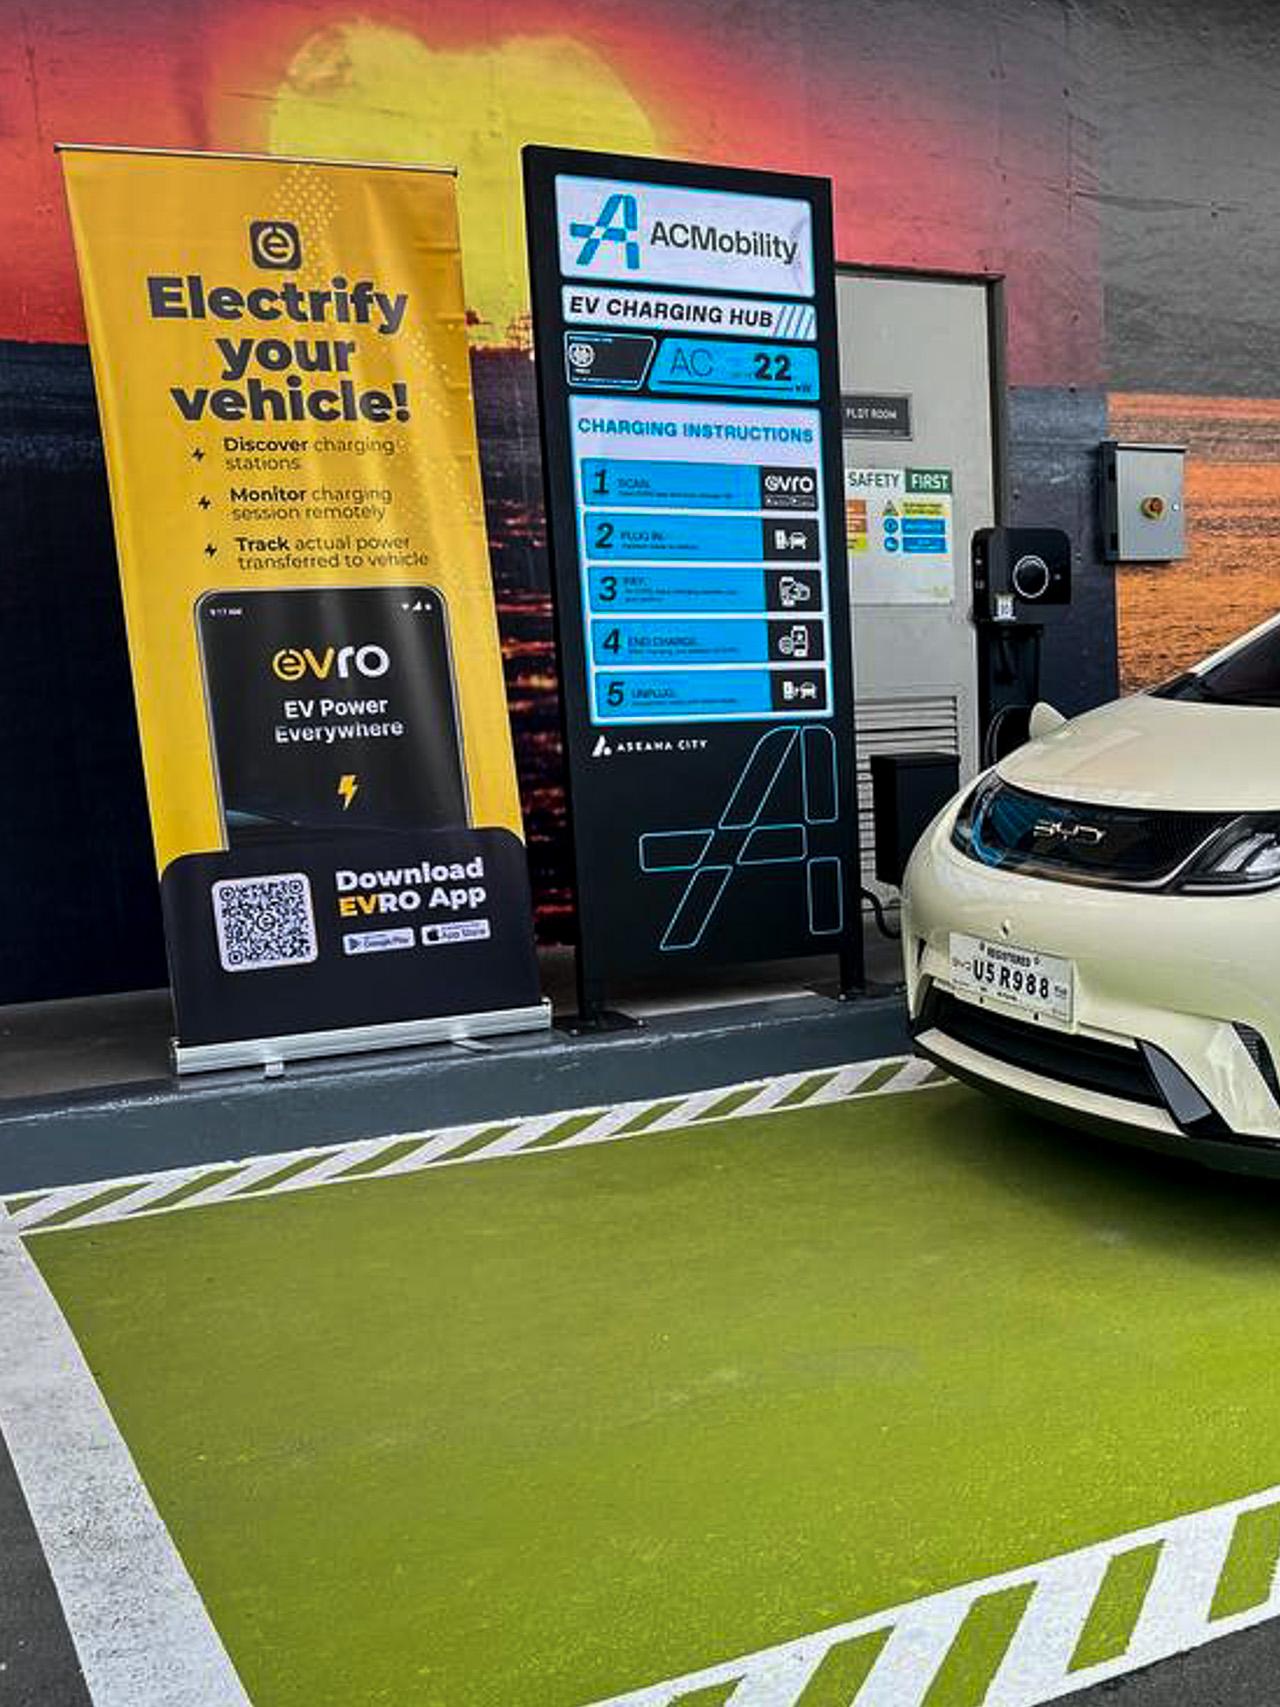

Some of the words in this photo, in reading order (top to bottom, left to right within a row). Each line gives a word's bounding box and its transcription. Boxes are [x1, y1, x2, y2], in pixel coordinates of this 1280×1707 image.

[650, 221, 797, 265] ACMobility
[147, 275, 408, 335] Electrify
[570, 296, 600, 315] EV
[606, 298, 722, 324] CHARGING
[730, 306, 773, 328] HUB
[216, 338, 355, 381] your
[670, 347, 713, 378] AC
[754, 352, 792, 382] 22
[170, 375, 410, 423] vehicle!
[871, 407, 897, 420] ROOM
[578, 418, 677, 438] CHARGING
[684, 421, 814, 445] INSTRUCTIONS
[224, 437, 308, 452] Discover
[314, 437, 395, 456] charging
[226, 455, 301, 471] stations
[592, 469, 609, 495] 1
[848, 471, 900, 487] SAFETY
[911, 473, 949, 490] FIRST
[230, 486, 307, 502] Monitor
[312, 486, 393, 505] charging
[232, 507, 300, 521] session
[305, 504, 386, 522] remotely
[235, 536, 291, 552] Track
[295, 535, 351, 551] actual
[356, 537, 410, 552] power
[595, 522, 614, 549] 2
[238, 553, 339, 571] transferred
[344, 554, 363, 568] to
[368, 551, 429, 567] vehicle
[599, 575, 617, 602] 3
[603, 628, 621, 654] 4
[272, 644, 390, 681] evro
[607, 681, 625, 707] 5
[284, 699, 314, 719] EV
[319, 698, 388, 717] Power
[275, 720, 404, 744] Everywhere
[677, 739, 708, 751] CITY
[335, 856, 484, 891] Download
[338, 890, 421, 917] EVRO
[429, 886, 486, 910] App
